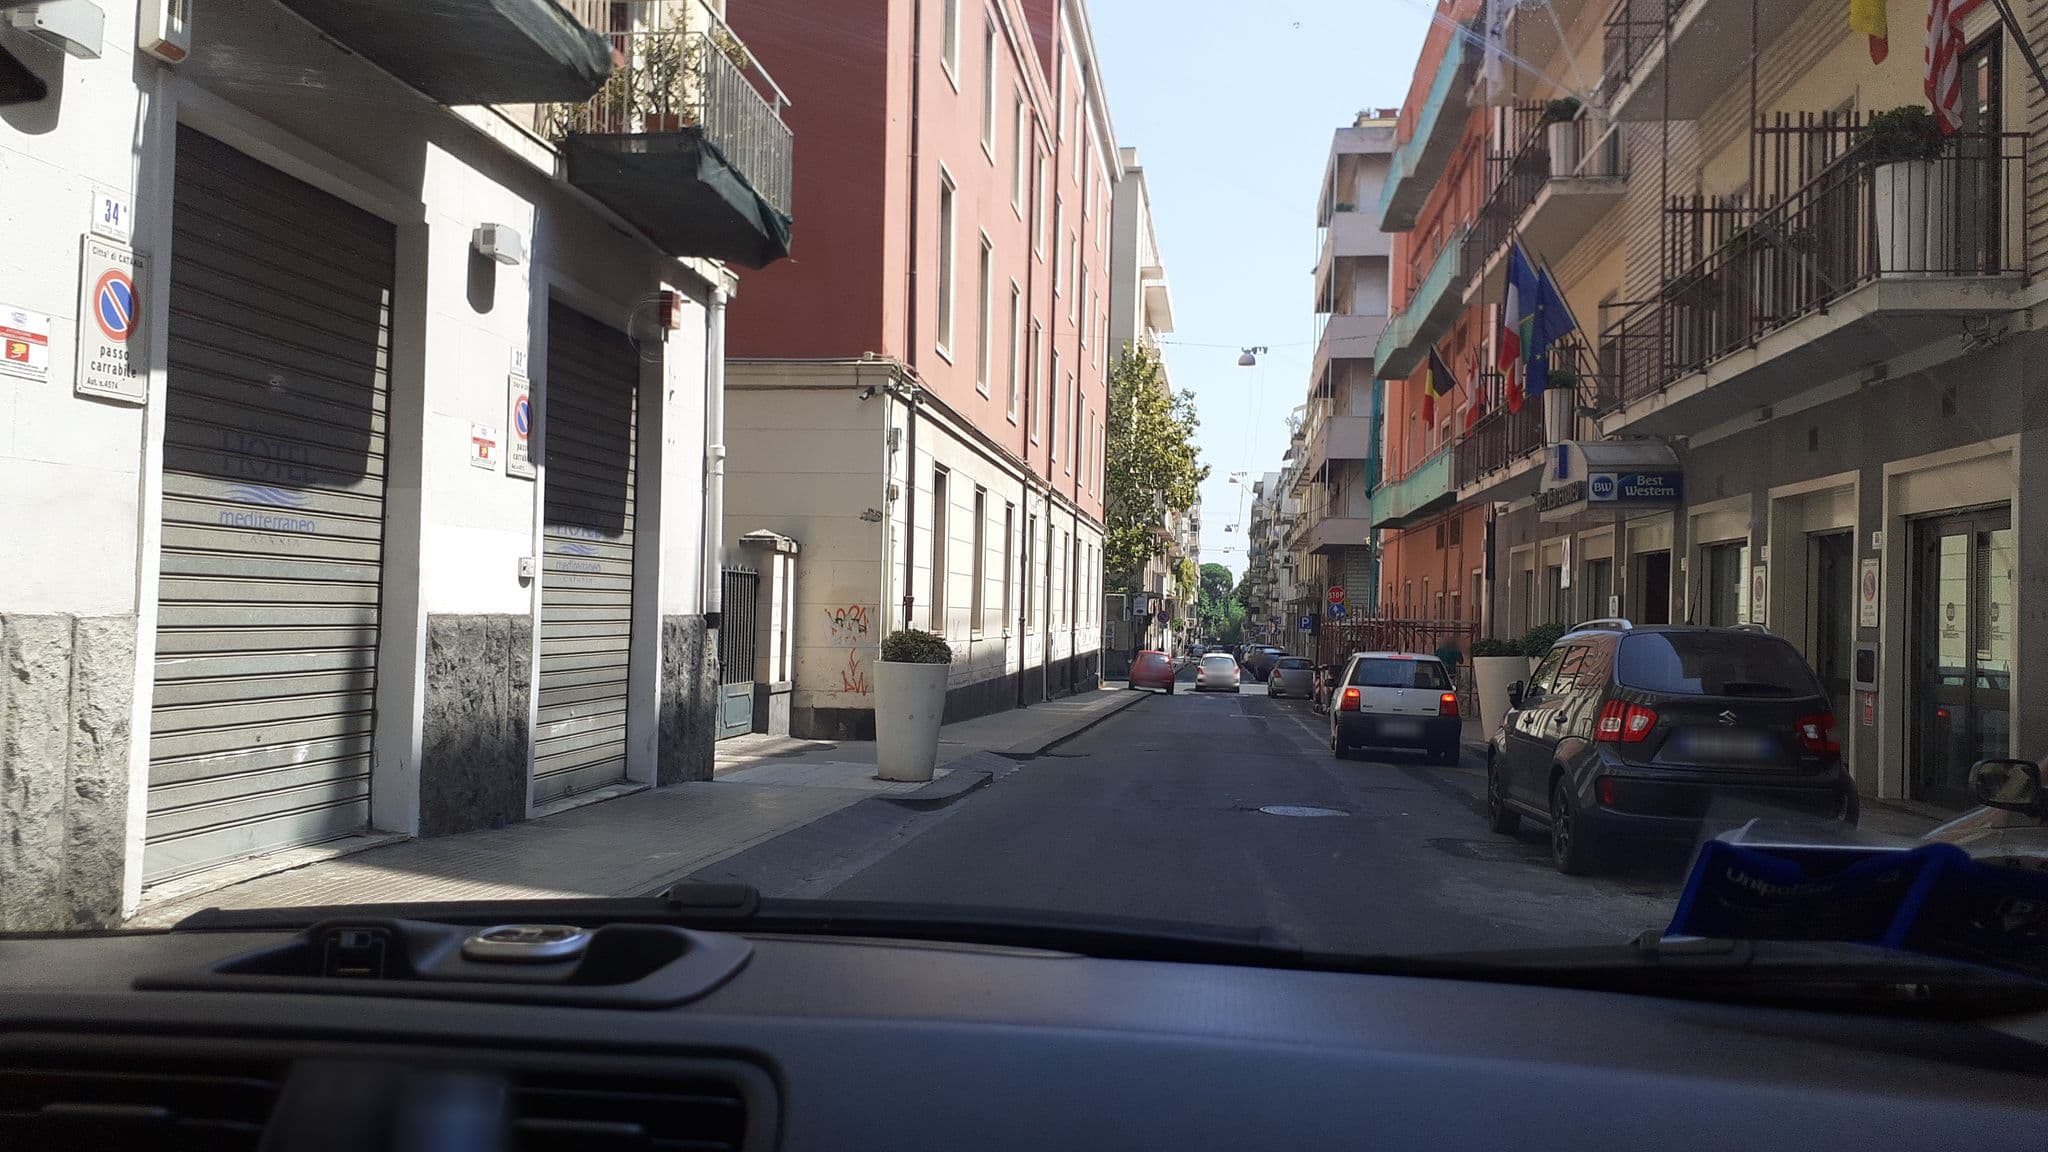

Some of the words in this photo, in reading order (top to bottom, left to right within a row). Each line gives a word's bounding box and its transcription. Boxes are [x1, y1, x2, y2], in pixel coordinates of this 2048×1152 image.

[100, 346, 130, 361] passo
[91, 361, 137, 379] carrabile
[222, 430, 318, 484] HOTEL
[1636, 475, 1664, 486] Best
[1594, 482, 1612, 492] BW
[1625, 485, 1675, 497] Western
[220, 511, 315, 532] mediterraneo
[1328, 591, 1344, 599] STOP
[1301, 617, 1310, 628] P
